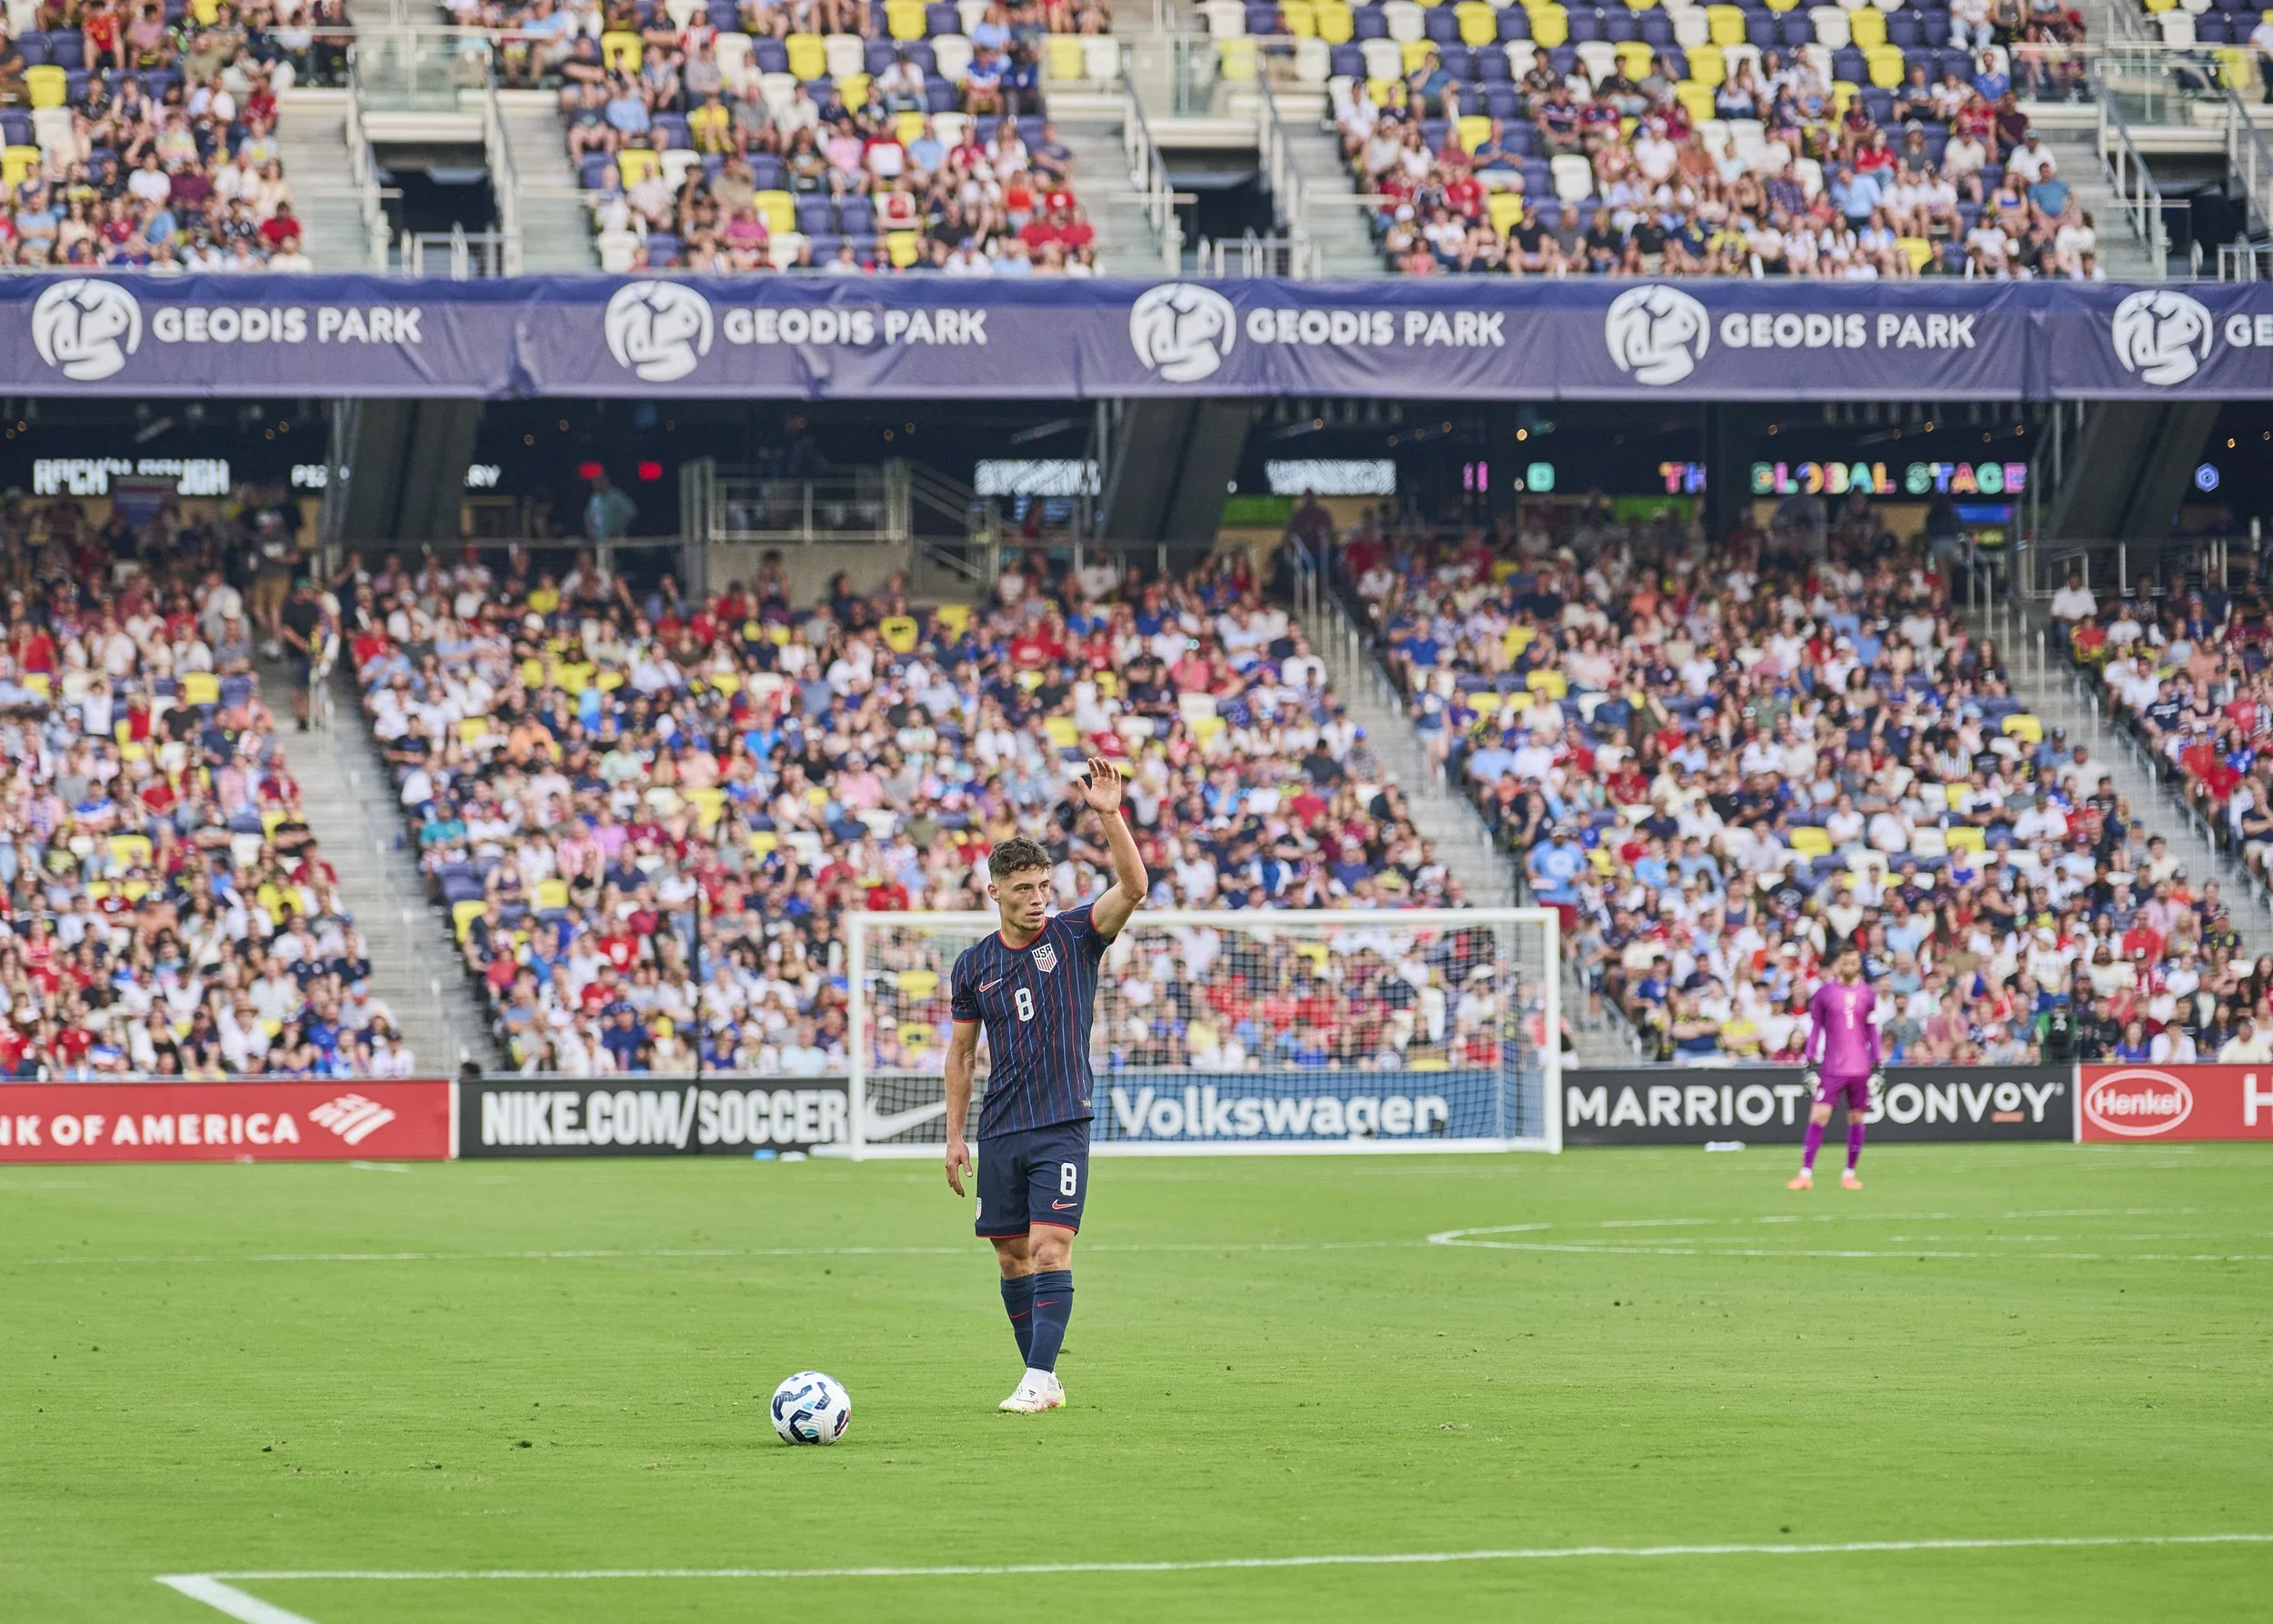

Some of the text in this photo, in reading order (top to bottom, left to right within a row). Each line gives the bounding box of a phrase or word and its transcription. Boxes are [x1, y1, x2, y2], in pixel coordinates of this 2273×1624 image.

[152, 306, 423, 344] GEODIS PARK
[724, 307, 987, 345] GEODIS PARK
[1246, 307, 1506, 347] GEODIS PARK
[1719, 313, 1977, 349] GEODIS PARK
[1751, 462, 1897, 494] GLOBAL
[1906, 462, 2027, 494] STAGE
[1033, 945, 1053, 959] USA
[1014, 987, 1035, 1022] 8
[481, 1086, 849, 1149] NIKE.COM/SOCCER
[1109, 1085, 1449, 1140] Volkswagen
[1567, 1084, 1806, 1127] MARRIOT
[2094, 1088, 2182, 1116] Henkel
[51, 1114, 105, 1146] OF
[112, 1112, 301, 1146] AMERICA
[1060, 1162, 1076, 1197] 8
